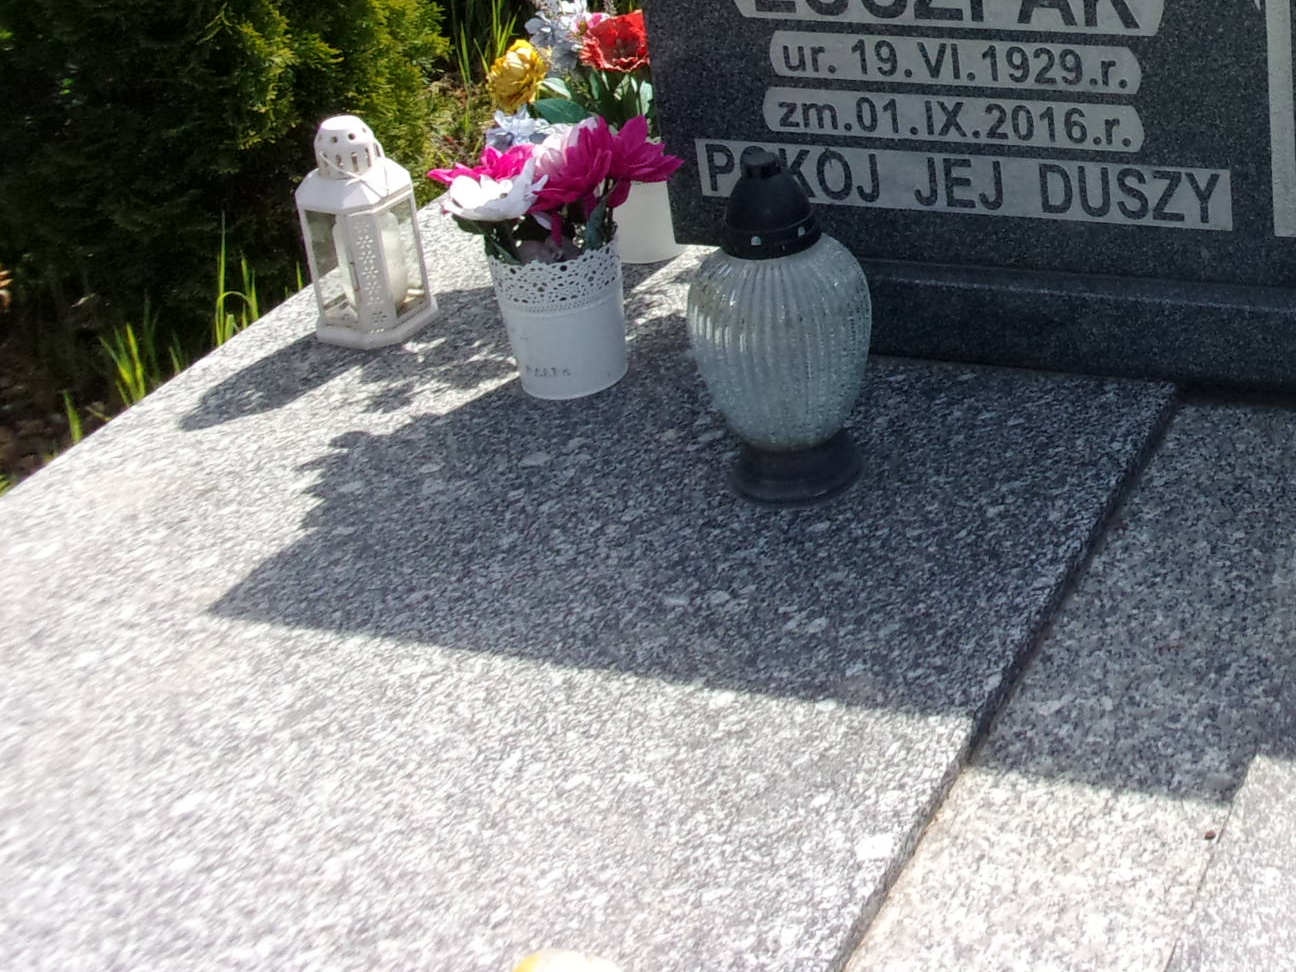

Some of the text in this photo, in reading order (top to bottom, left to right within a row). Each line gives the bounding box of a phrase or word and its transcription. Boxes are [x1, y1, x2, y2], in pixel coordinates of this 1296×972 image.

[705, 143, 1223, 225] PKÓJ JEJ DUSZY
